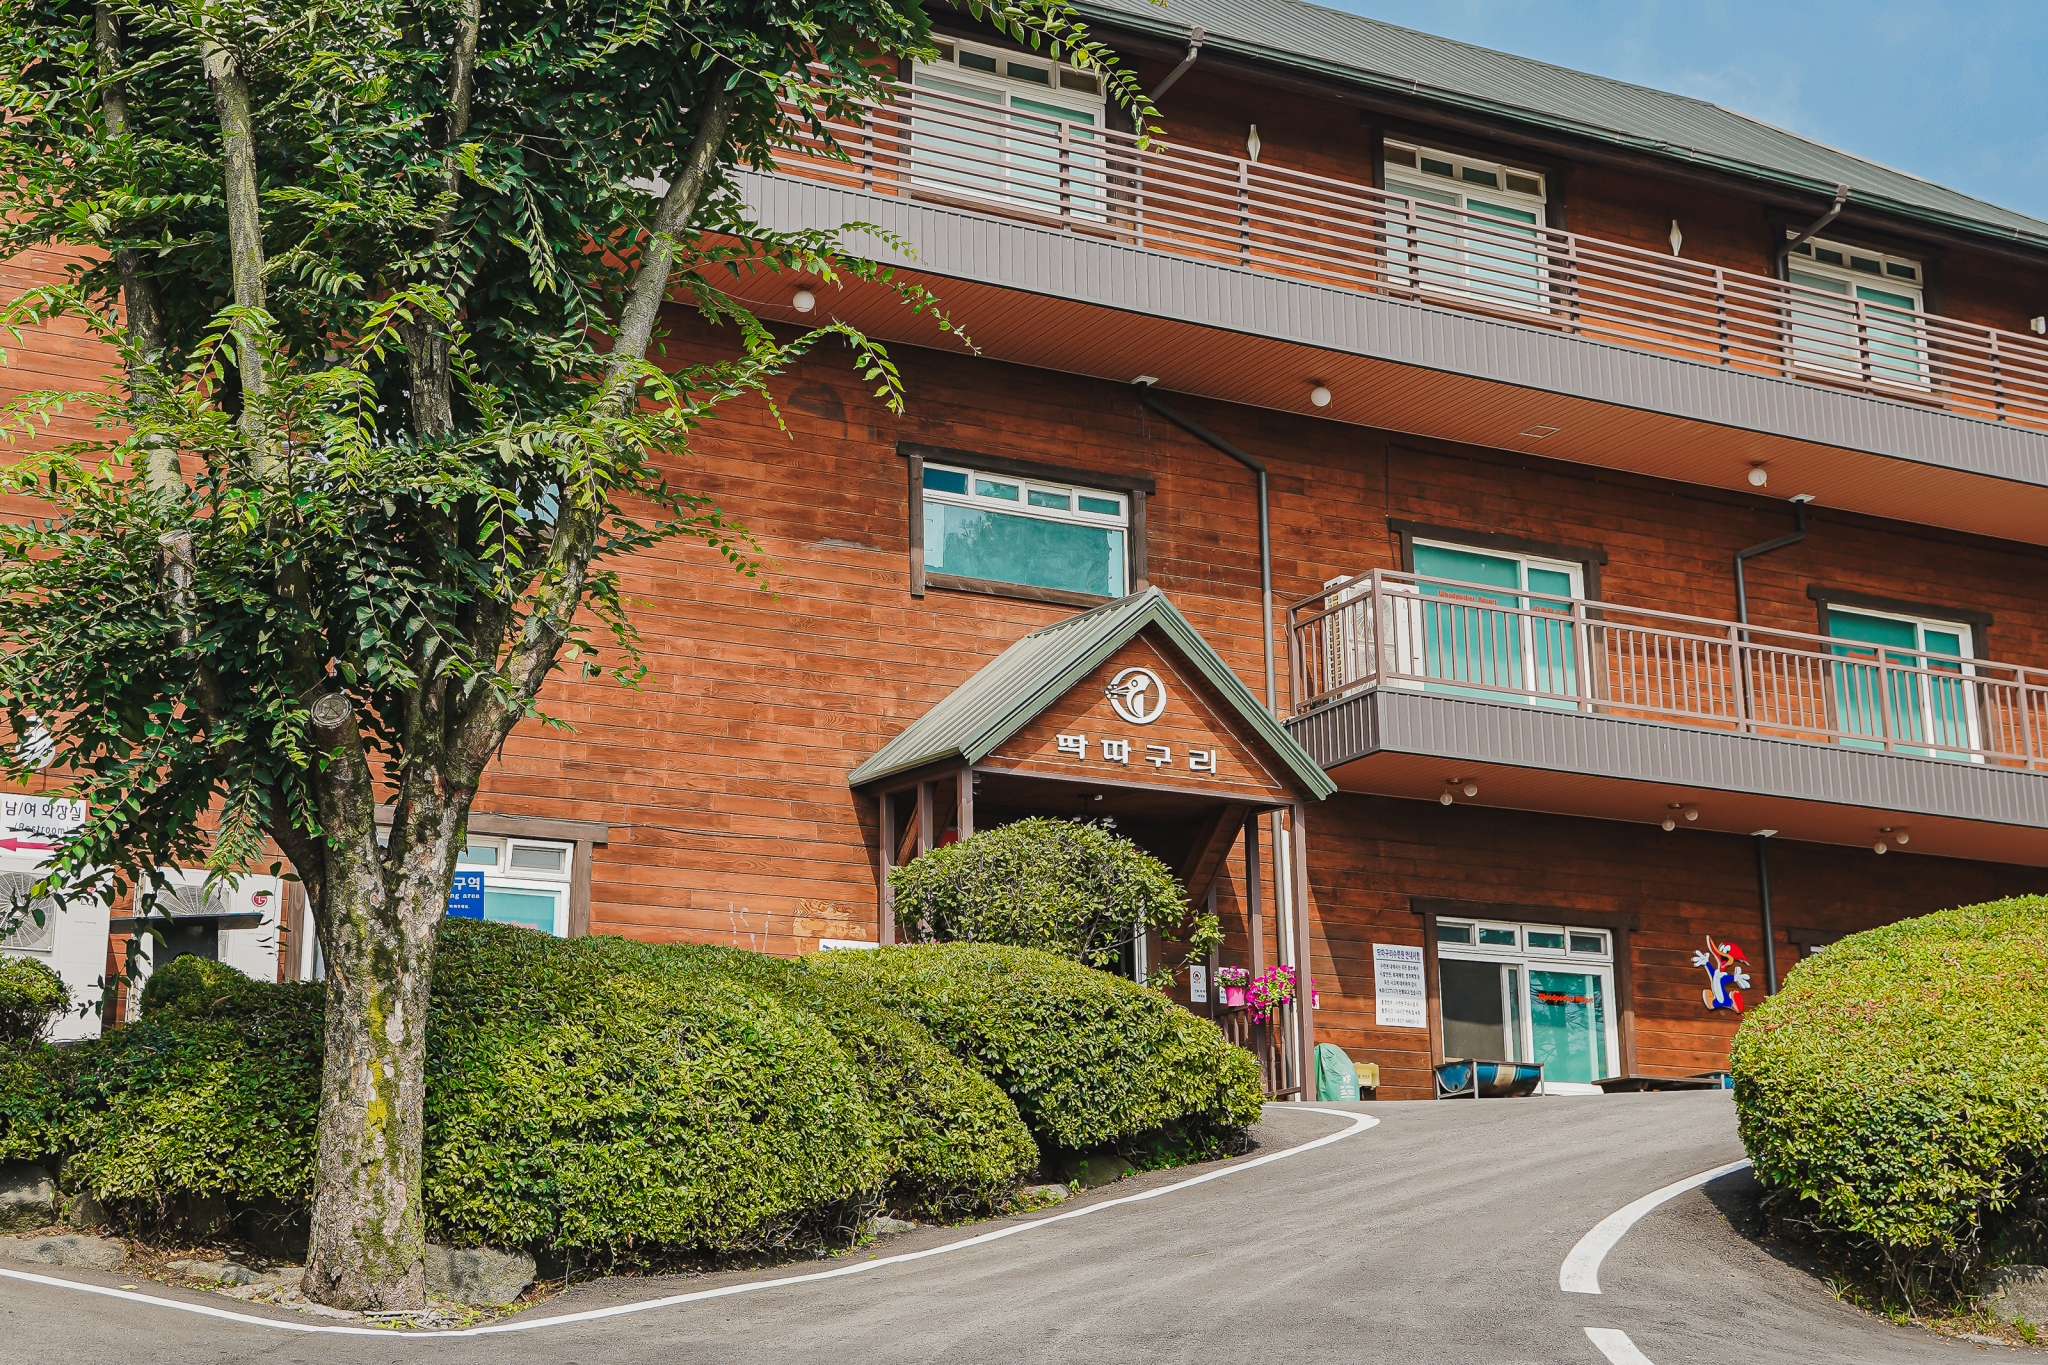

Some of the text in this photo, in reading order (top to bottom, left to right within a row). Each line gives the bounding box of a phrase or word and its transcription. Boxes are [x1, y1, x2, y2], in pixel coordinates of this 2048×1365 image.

[1056, 734, 1217, 775] 딱따구리
[5, 800, 81, 822] 남/여 화장실
